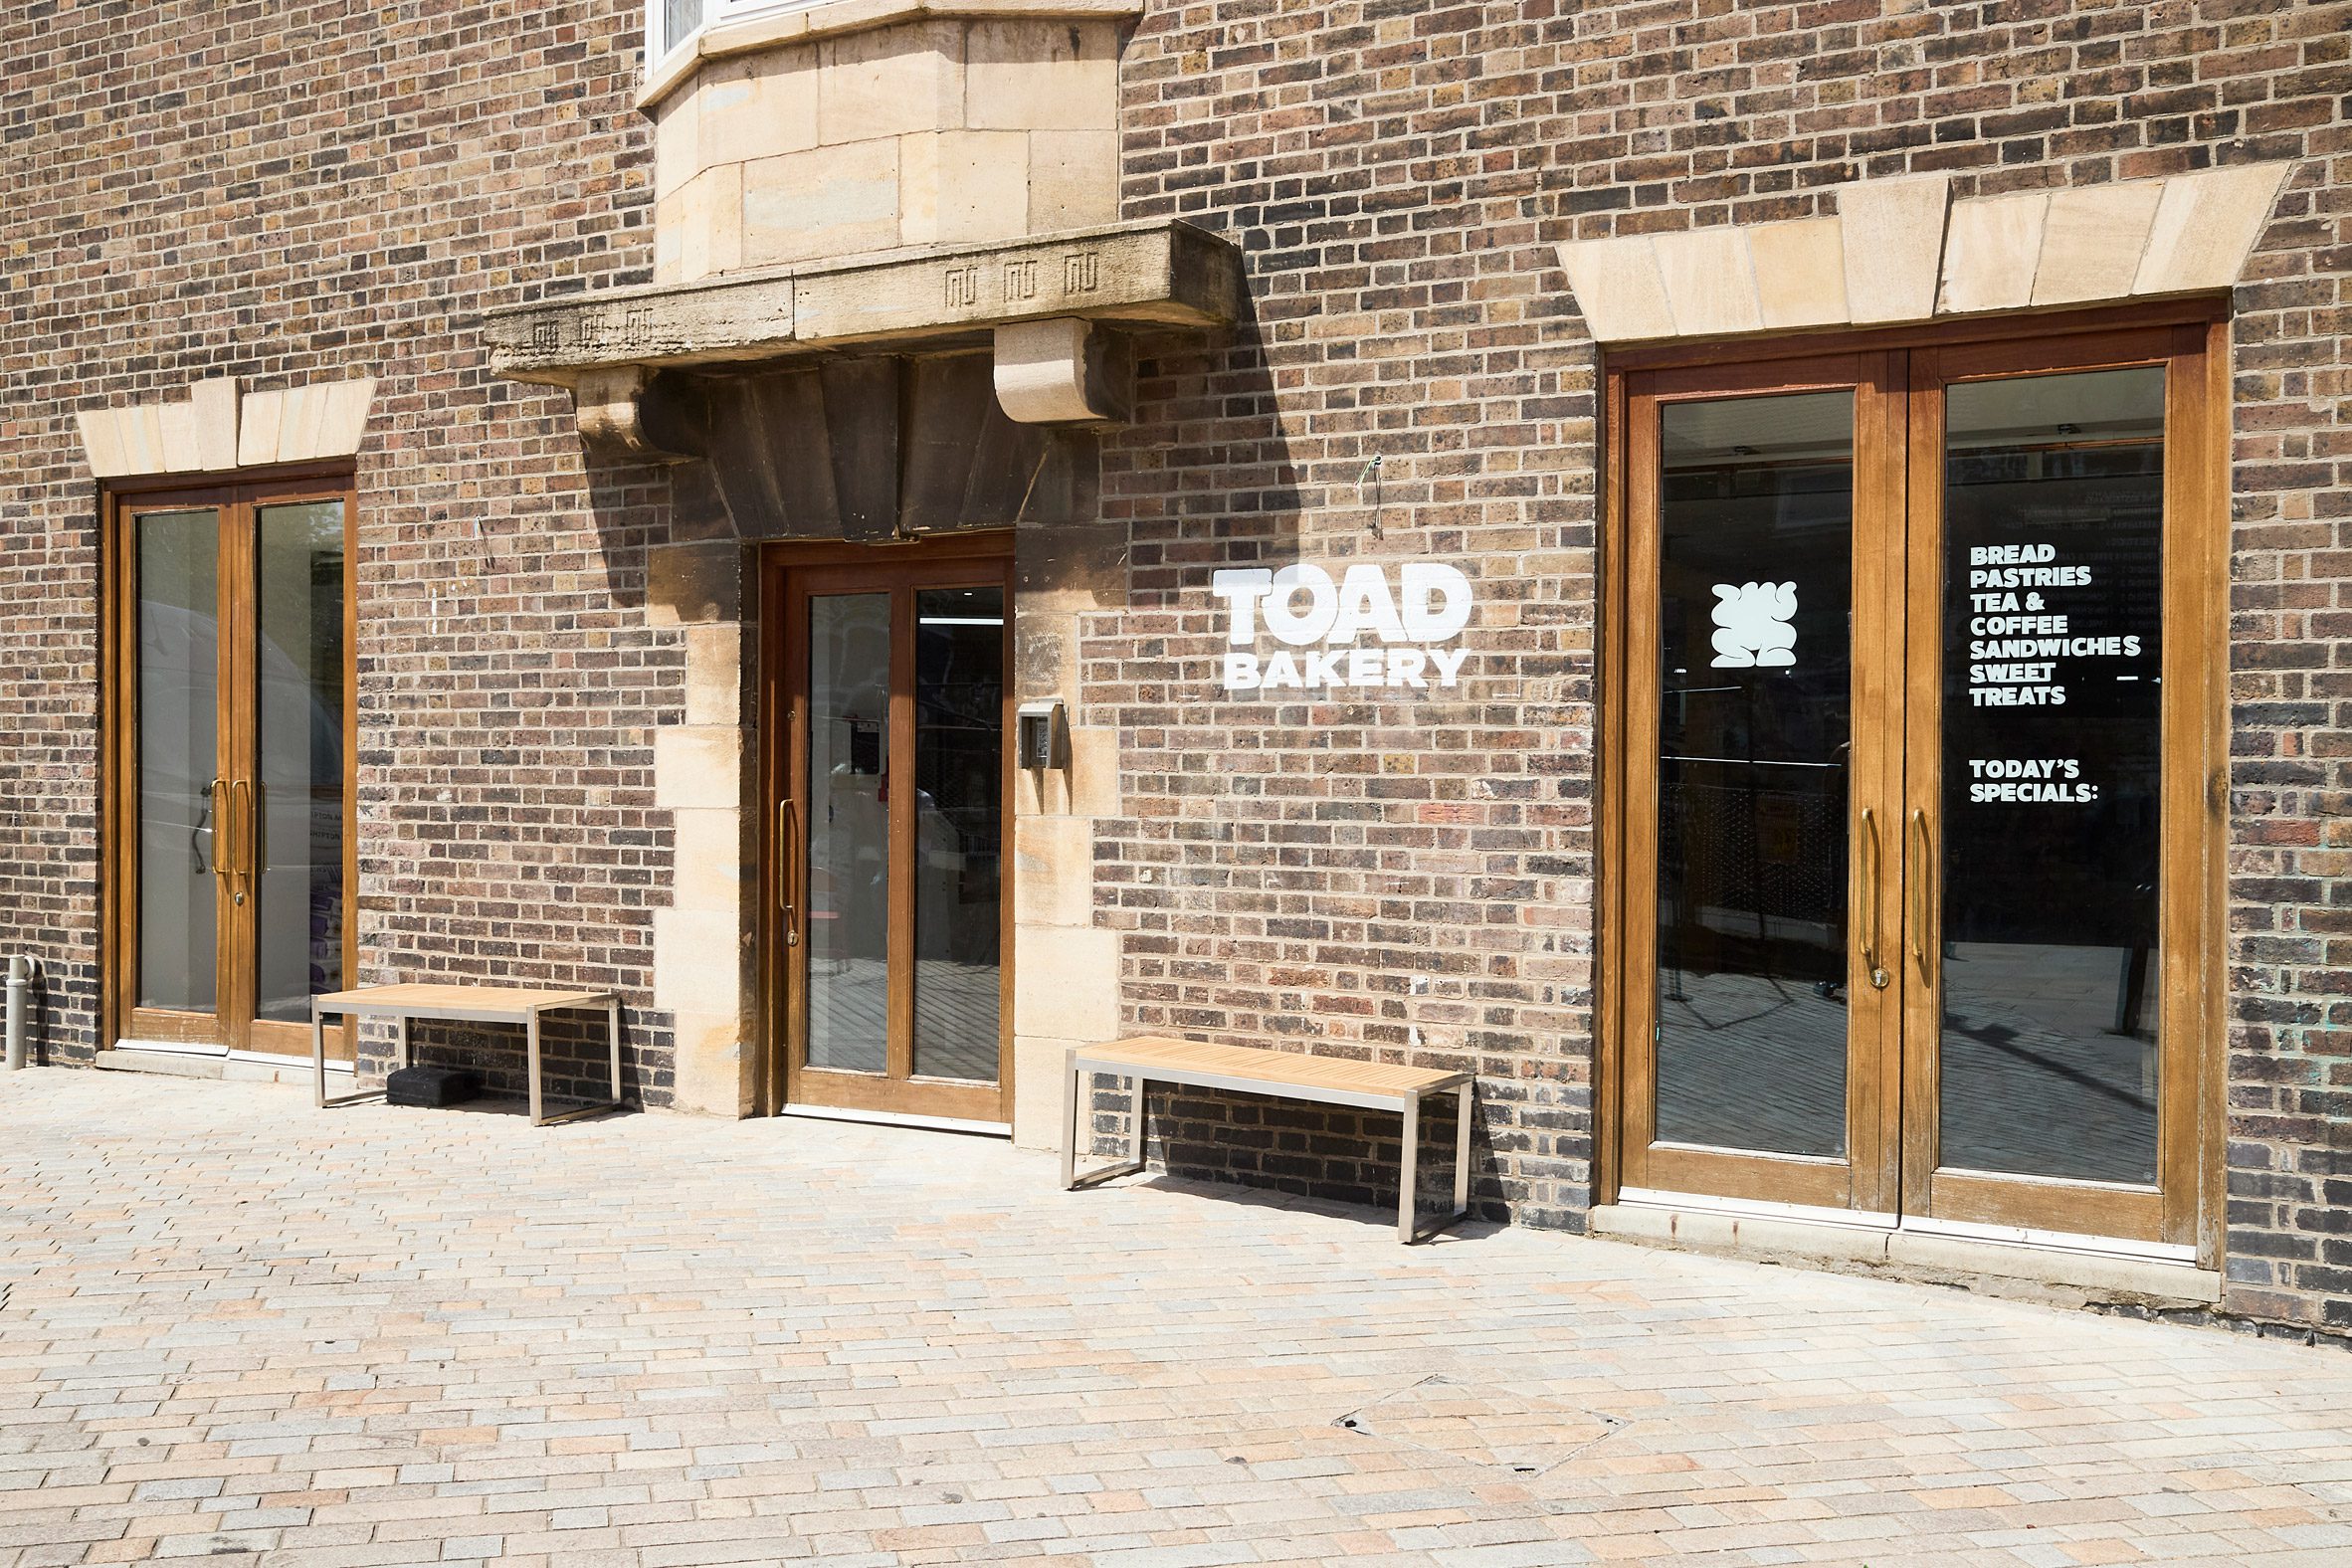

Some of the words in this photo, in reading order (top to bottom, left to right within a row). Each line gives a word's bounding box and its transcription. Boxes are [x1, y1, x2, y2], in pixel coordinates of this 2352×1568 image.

[1970, 544, 2056, 566] BREAD
[1970, 566, 2091, 588] PASTRIES
[1213, 563, 1473, 646] TOAD
[1970, 593, 2020, 612] TEA
[2026, 592, 2045, 611] &
[1970, 615, 2068, 636] COFFEE
[1970, 635, 2141, 660] SANDWICHES
[1224, 648, 1470, 689] BAKERY
[1969, 663, 2057, 684] SWEET
[1969, 686, 2066, 706] TREATS
[1969, 759, 2079, 778] TODAY'S
[1969, 783, 2098, 802] SPECIALS:
